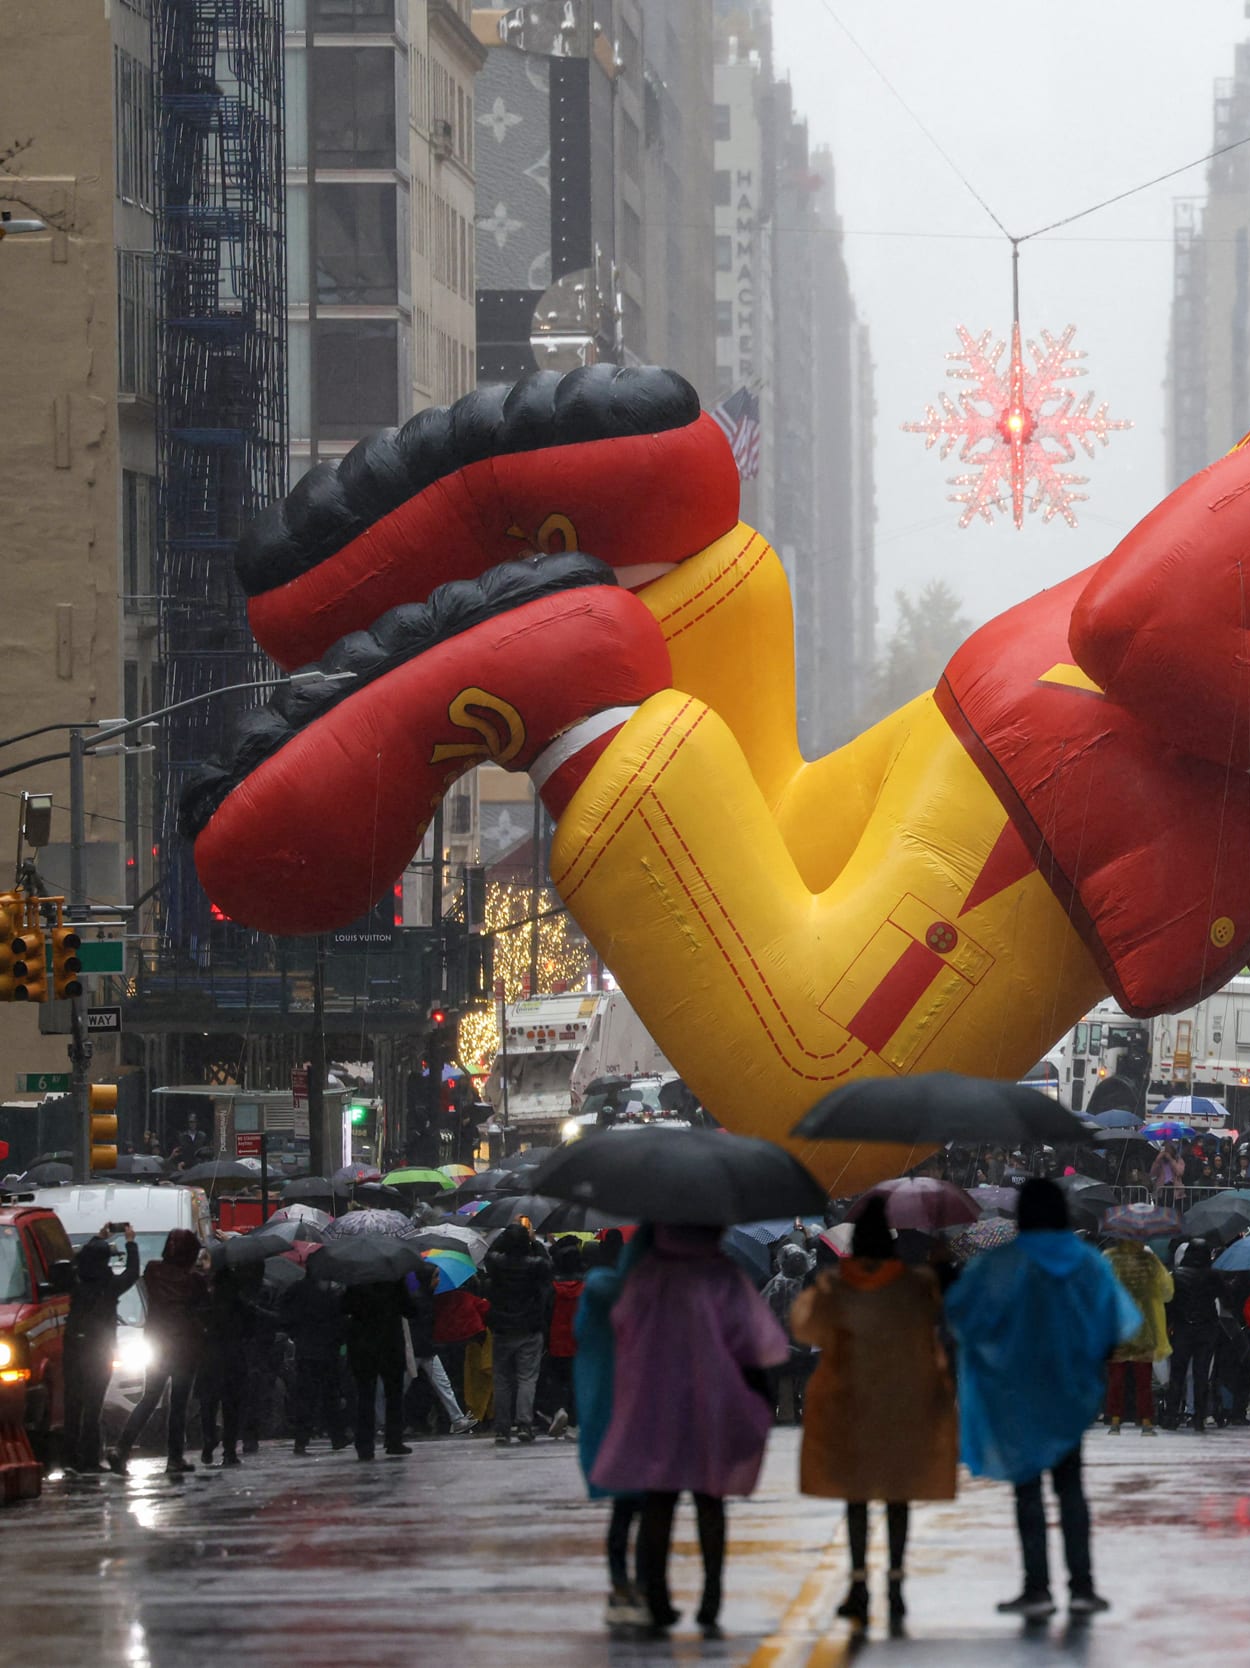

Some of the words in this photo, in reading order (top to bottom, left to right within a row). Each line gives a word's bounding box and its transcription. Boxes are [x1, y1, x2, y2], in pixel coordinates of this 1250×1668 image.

[736, 169, 753, 377] HAMMACHER
[335, 934, 358, 942] LOUIS
[360, 934, 392, 942] VUITTON
[88, 1015, 113, 1026] WAY
[39, 1077, 47, 1090] 6
